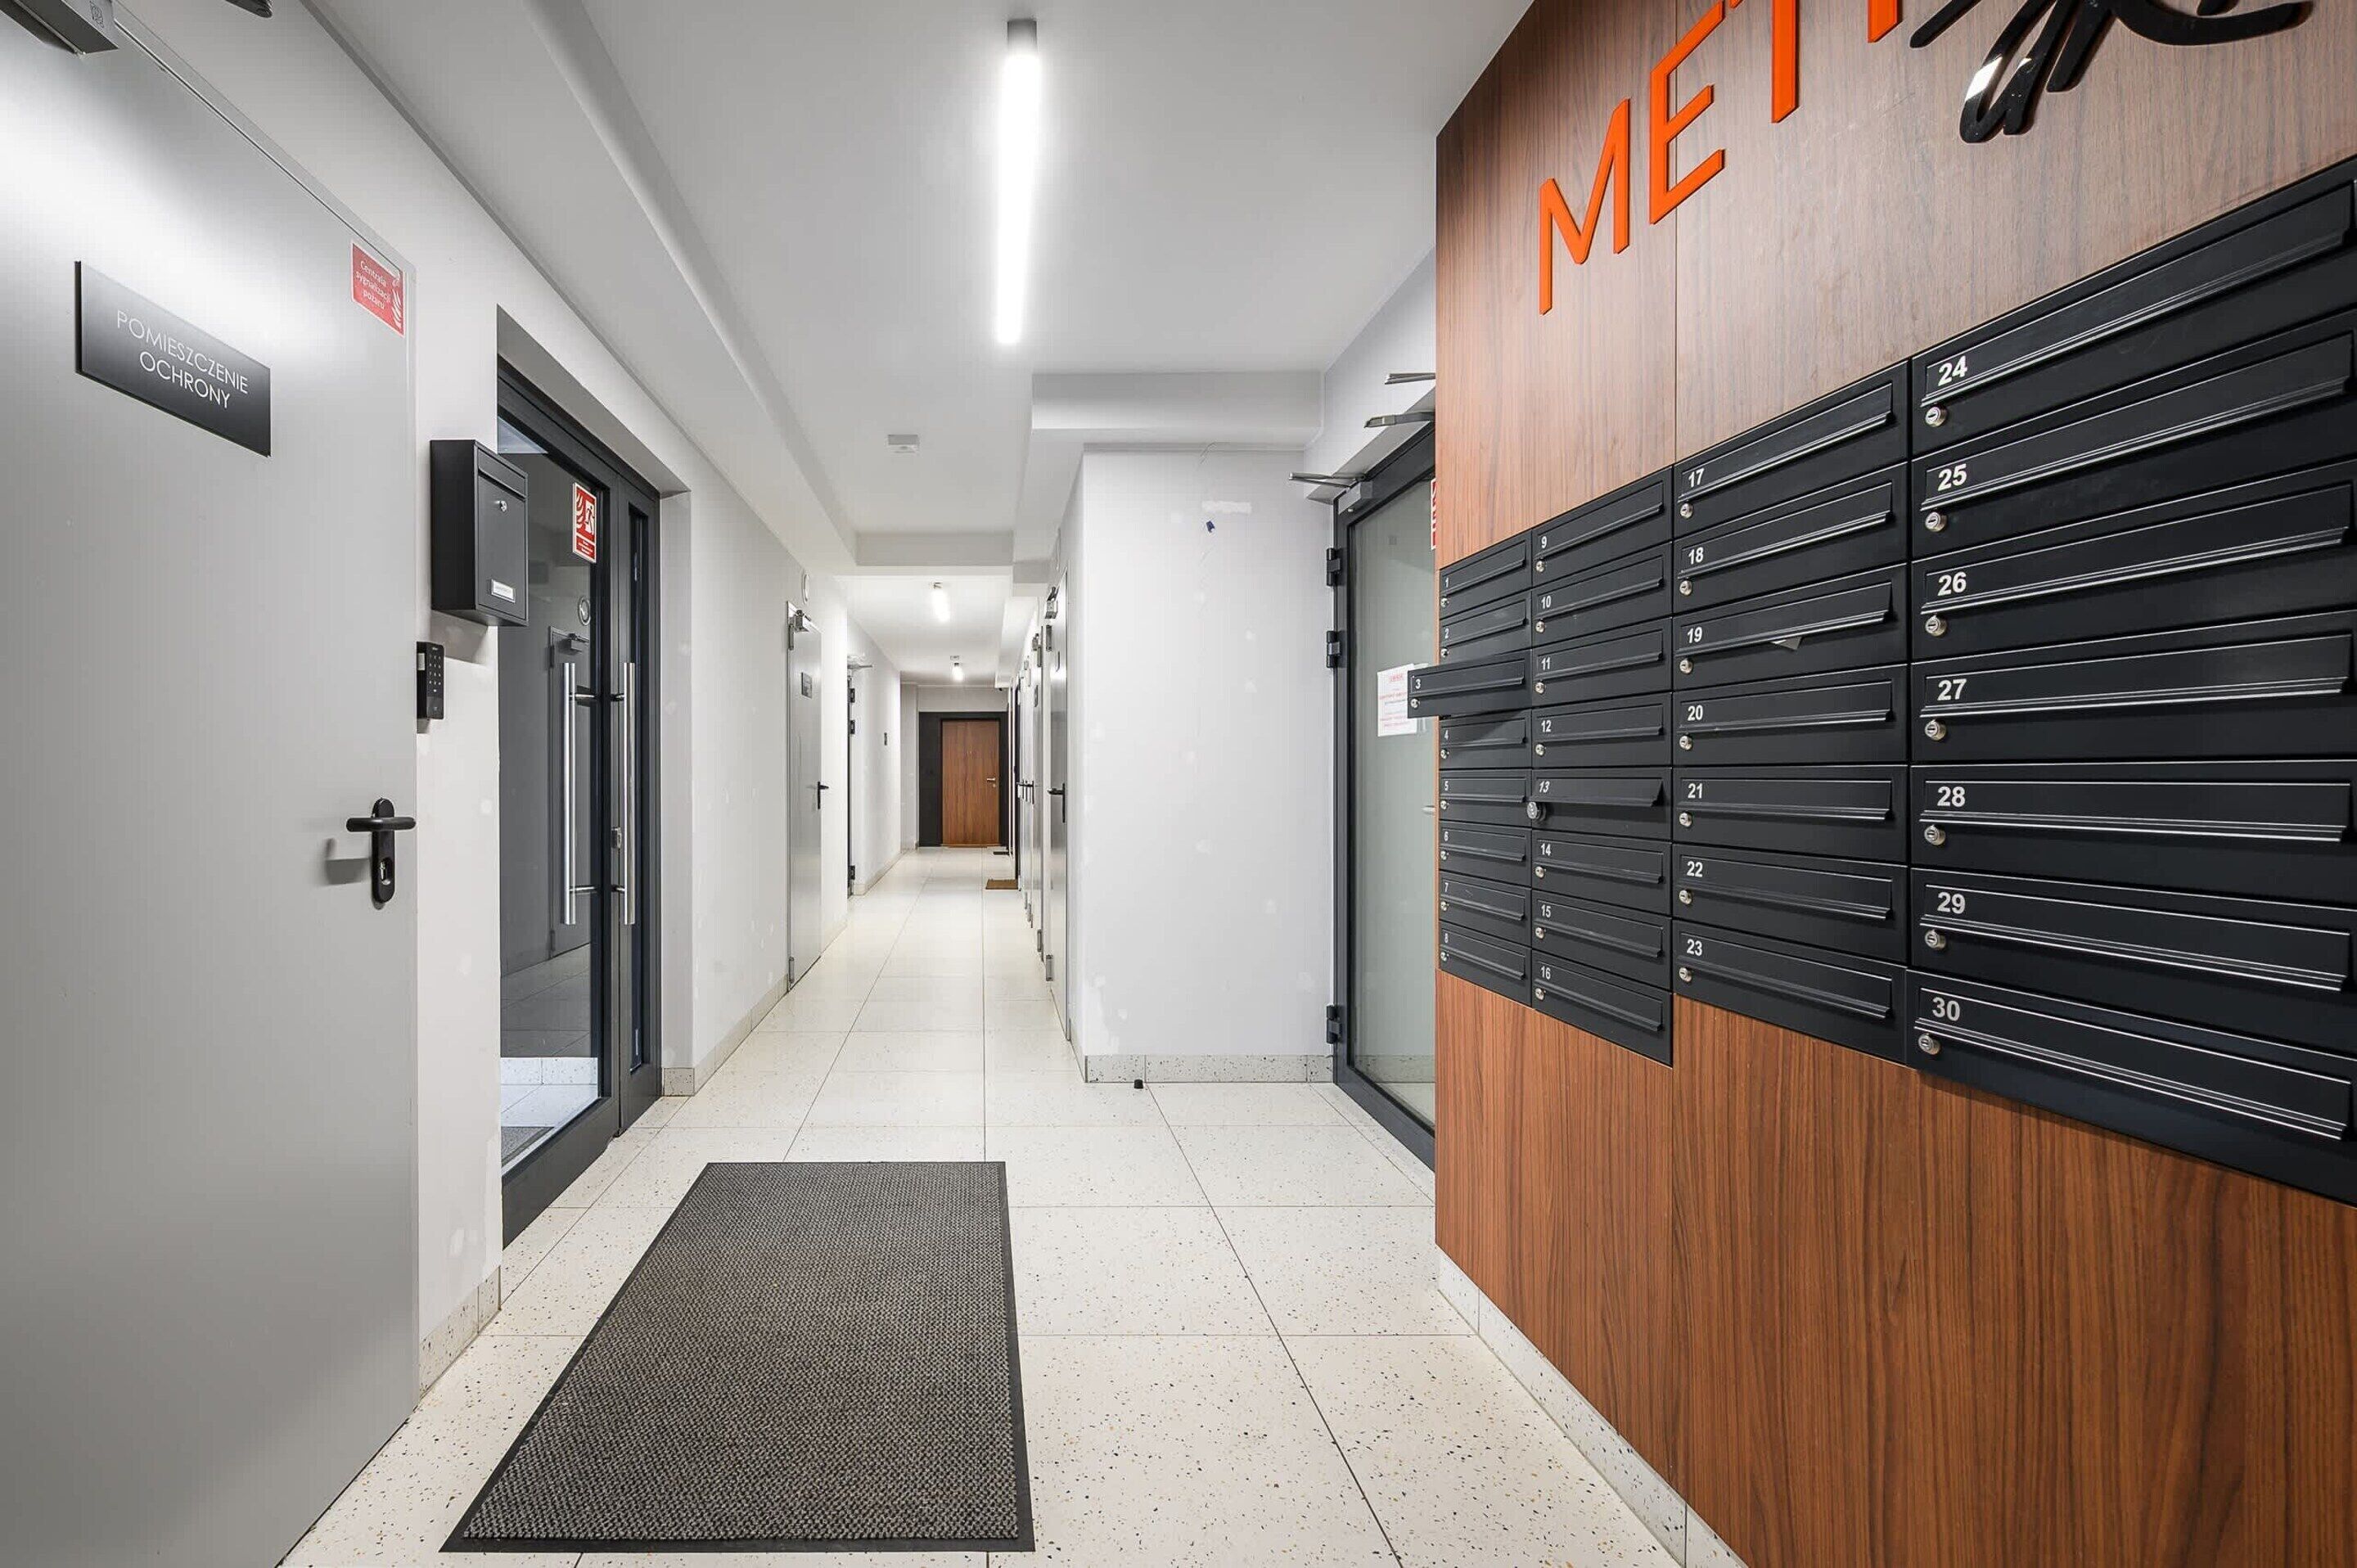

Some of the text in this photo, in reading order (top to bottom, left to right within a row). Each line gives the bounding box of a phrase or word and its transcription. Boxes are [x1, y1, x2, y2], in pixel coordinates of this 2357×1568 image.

[1539, 0, 1901, 315] MET
[117, 309, 248, 394] POMIESZCZENIE
[1937, 355, 1968, 387] 24
[139, 351, 231, 409] OCHRONY
[1688, 467, 1705, 488] 17
[1937, 463, 1967, 492] 25
[1541, 535, 1548, 549] 9
[1688, 547, 1704, 565] 18
[1444, 577, 1449, 588] 1
[1937, 571, 1967, 597] 26
[1541, 595, 1552, 610] 10
[1444, 627, 1449, 639] 2
[1687, 626, 1703, 644] 19
[1541, 656, 1551, 671] 11
[1415, 678, 1422, 690] 3
[1936, 678, 1967, 701] 27
[1687, 705, 1704, 722] 20
[1541, 719, 1552, 732] 12
[1444, 729, 1449, 740] 4
[1444, 780, 1449, 791] 5
[1539, 780, 1550, 793] 13
[1687, 782, 1703, 799] 21
[1936, 786, 1966, 808] 28
[1444, 831, 1449, 842] 6
[1540, 843, 1552, 856] 14
[1686, 860, 1703, 878] 22
[1444, 881, 1449, 893] 7
[1541, 903, 1552, 918] 15
[1936, 891, 1966, 914] 29
[1444, 932, 1449, 944] 8
[1686, 938, 1703, 957] 23
[1540, 965, 1551, 980] 16
[1931, 996, 1961, 1021] 30
